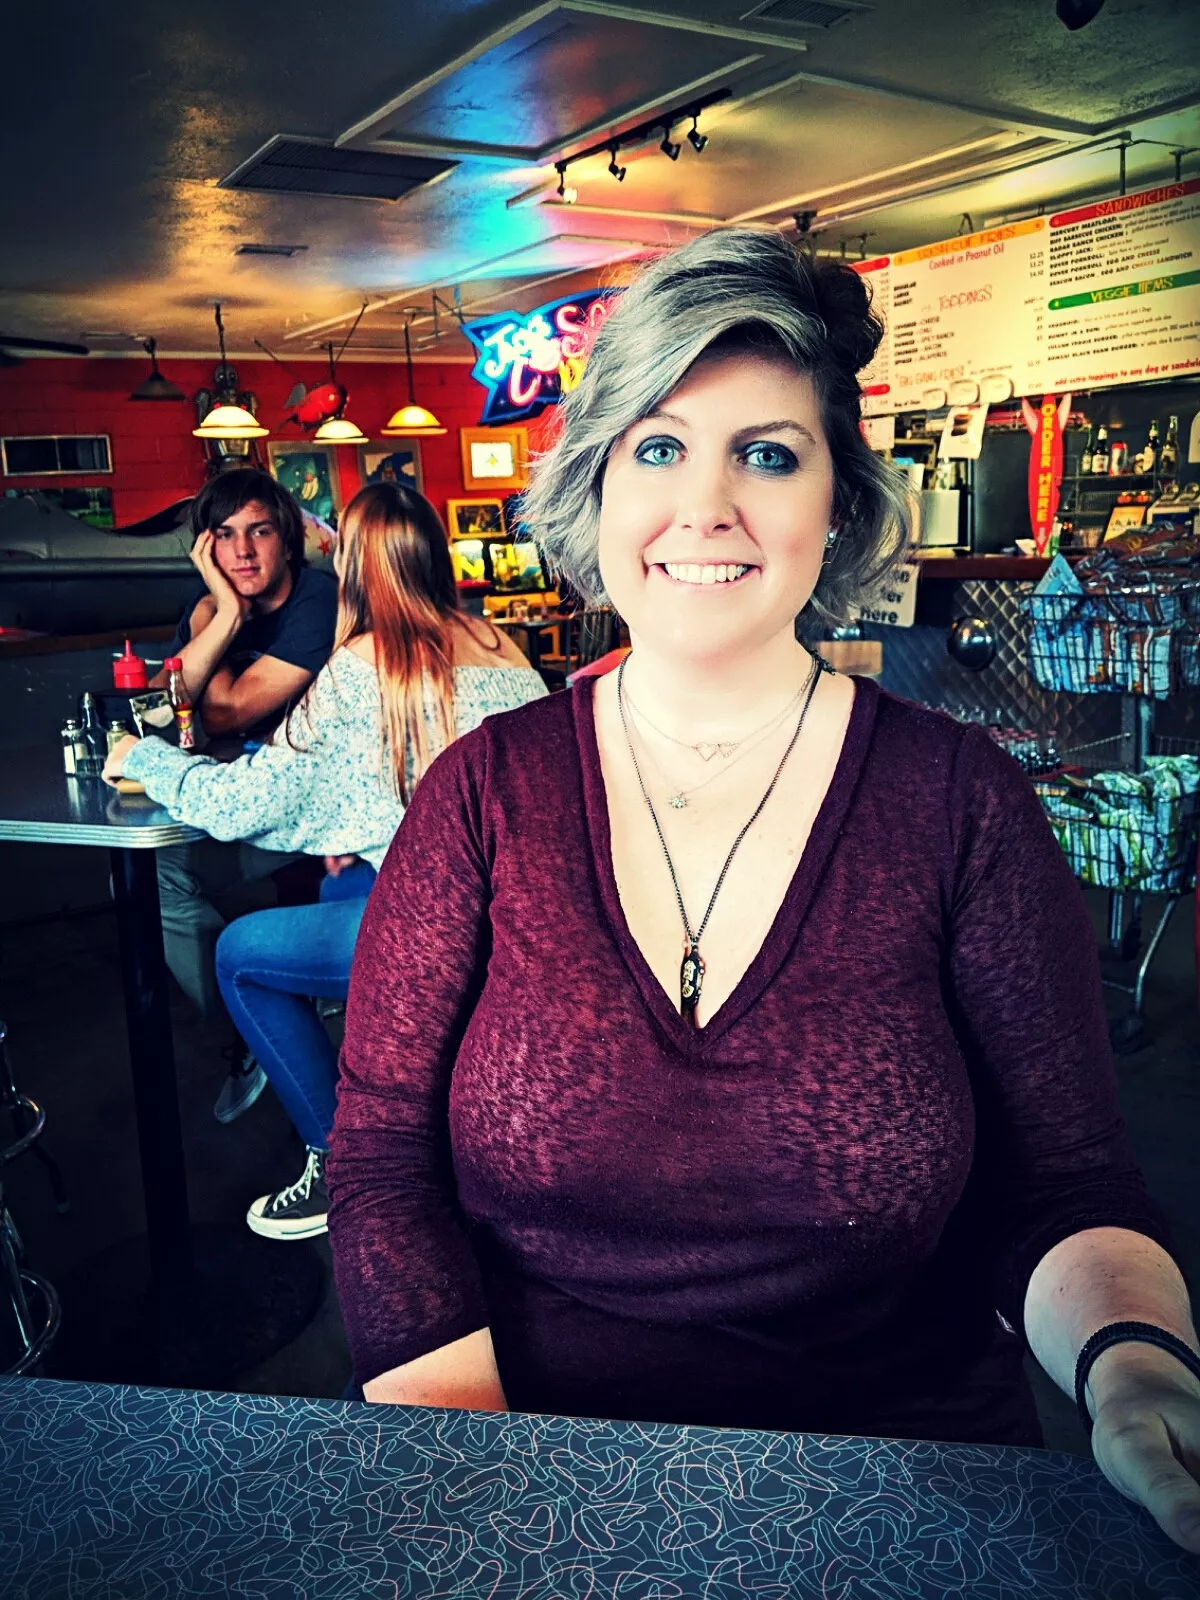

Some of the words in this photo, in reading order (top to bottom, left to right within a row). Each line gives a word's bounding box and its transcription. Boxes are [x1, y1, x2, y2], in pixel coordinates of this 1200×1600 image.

[1095, 183, 1185, 216] SANDWICHES
[1050, 225, 1079, 237] MERCURY
[1081, 216, 1117, 229] MEATLOAF:
[1063, 230, 1093, 242] BARBECUE
[1094, 223, 1122, 235] CHICKEN:
[1050, 243, 1070, 253] RADAR
[1072, 238, 1094, 248] RANCH
[1095, 231, 1124, 242] CHICKEN
[929, 256, 955, 270] Cooked
[957, 254, 964, 263] in
[965, 248, 991, 262] Peanut
[993, 242, 1005, 255] Oil
[1115, 264, 1130, 273] AND
[1156, 251, 1193, 265] SANDWICH
[1121, 254, 1135, 262] AND
[1137, 248, 1160, 259] CHEESE
[939, 284, 993, 311] TOPPINGS
[1090, 284, 1134, 303] VEGGIE
[1138, 276, 1174, 294] ITEMS
[1055, 376, 1067, 386] add
[1088, 371, 1118, 381] toppings
[1120, 369, 1128, 377] to
[1130, 368, 1143, 377] any
[1145, 364, 1159, 374] dog
[1161, 364, 1169, 372] or
[1040, 403, 1056, 468] ORDER
[1037, 472, 1052, 523] HERE
